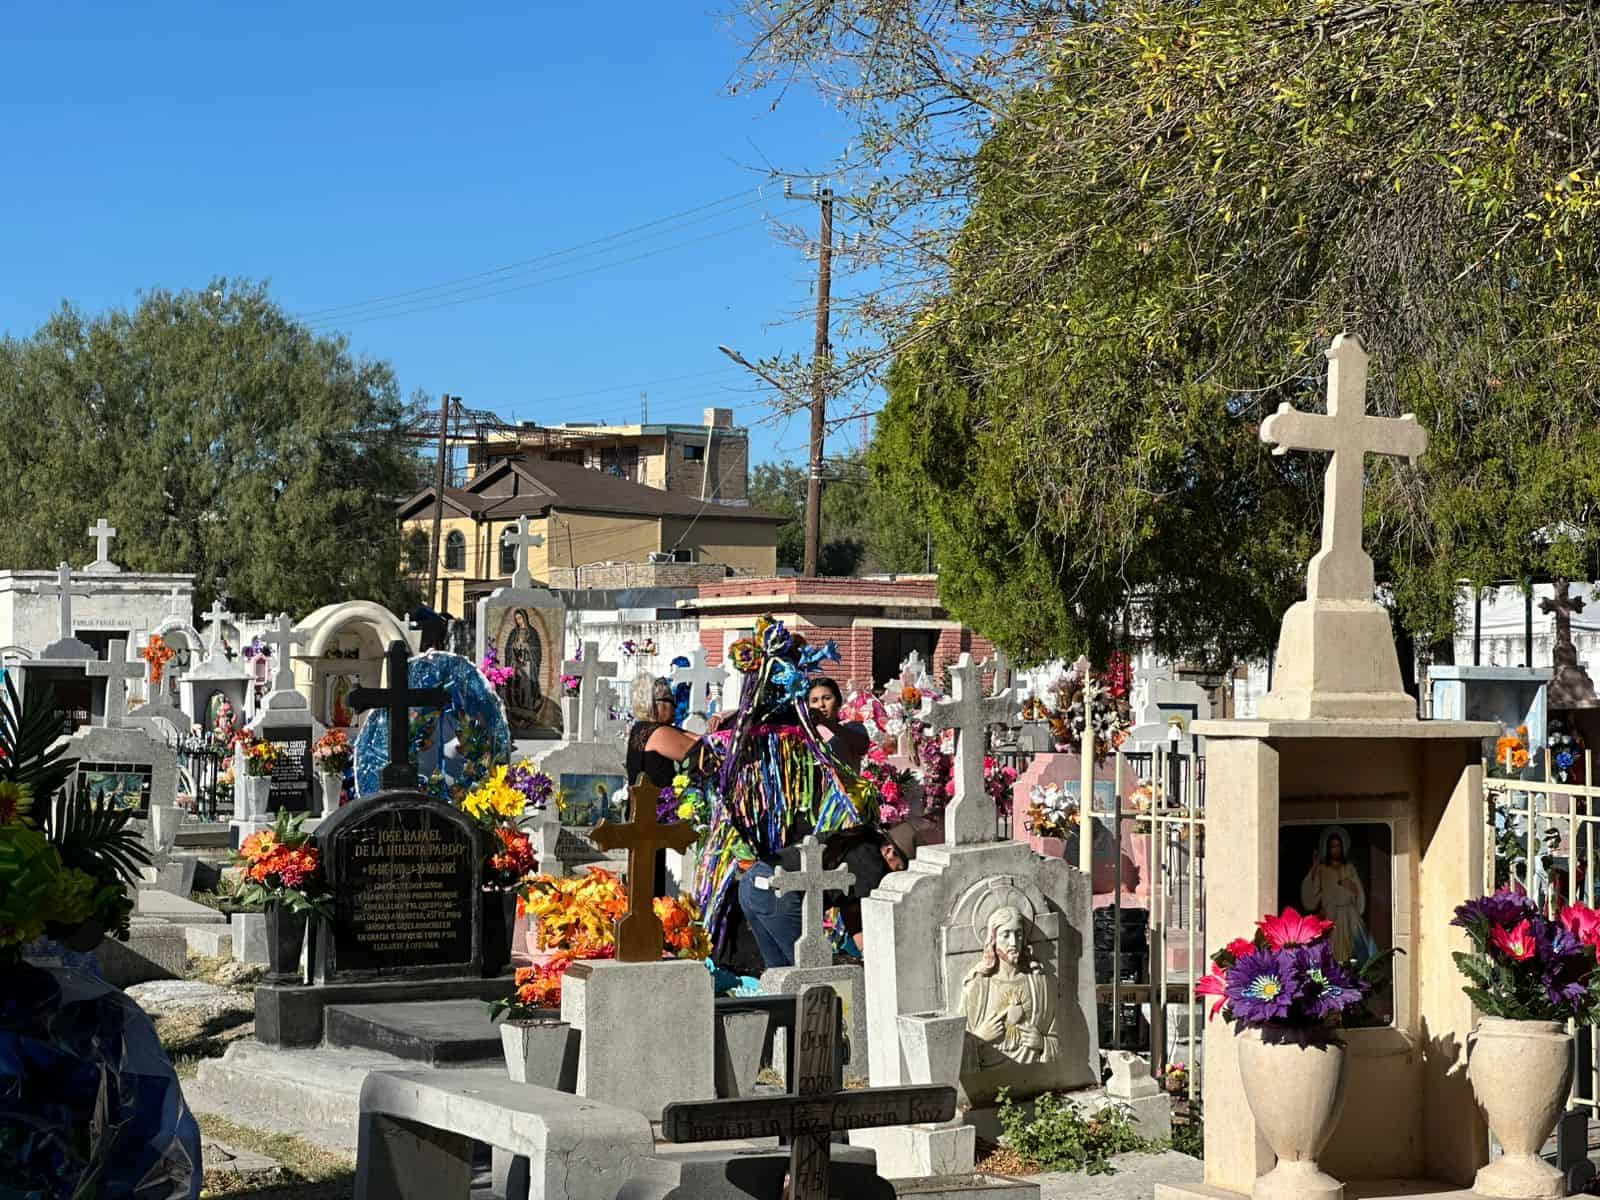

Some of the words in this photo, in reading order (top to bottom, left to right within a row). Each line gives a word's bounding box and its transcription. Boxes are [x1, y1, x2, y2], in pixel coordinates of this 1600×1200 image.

[403, 829, 441, 841] RAFAEL
[355, 844, 370, 857] DE
[371, 844, 385, 857] LA
[386, 843, 426, 857] HUERTA
[428, 843, 464, 856] PARDO
